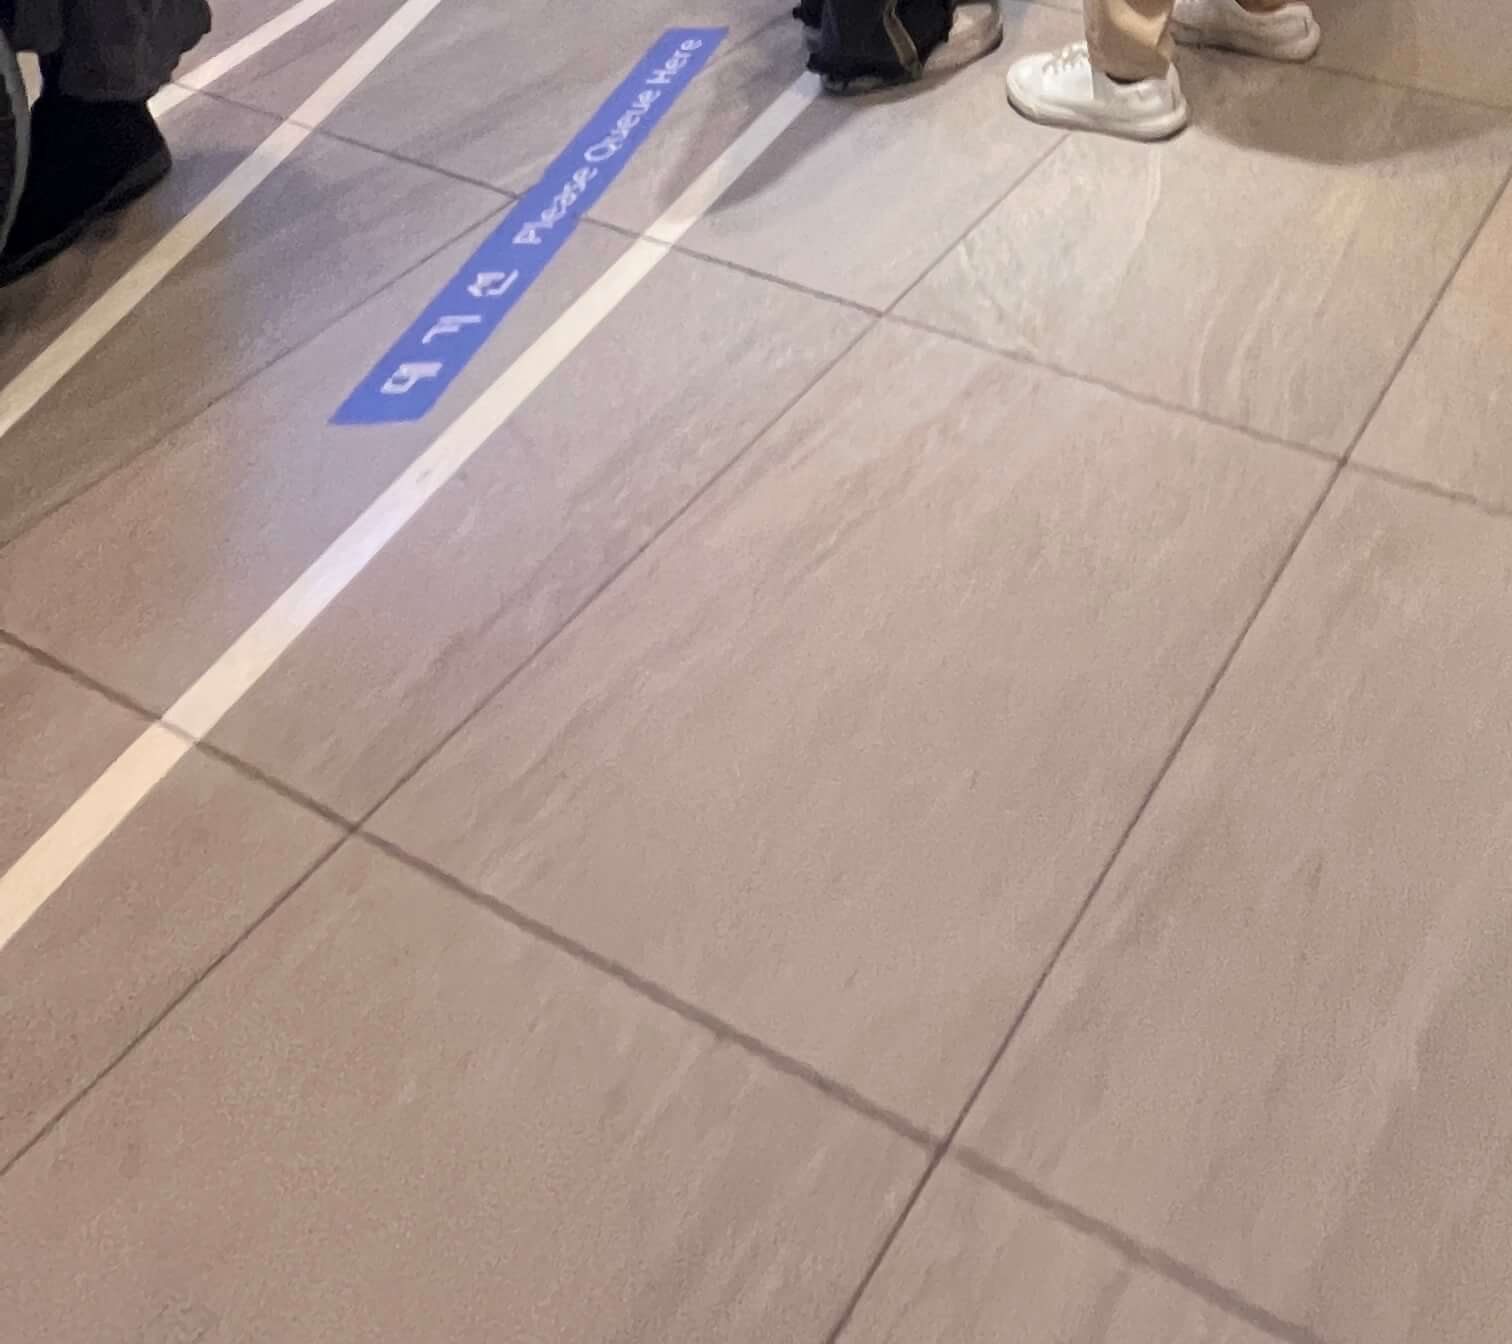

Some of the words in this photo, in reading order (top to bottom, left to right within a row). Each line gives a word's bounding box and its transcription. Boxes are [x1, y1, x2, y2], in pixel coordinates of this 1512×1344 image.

[512, 166, 598, 246] Please
[584, 89, 661, 165] Queue
[646, 37, 704, 86] Here
